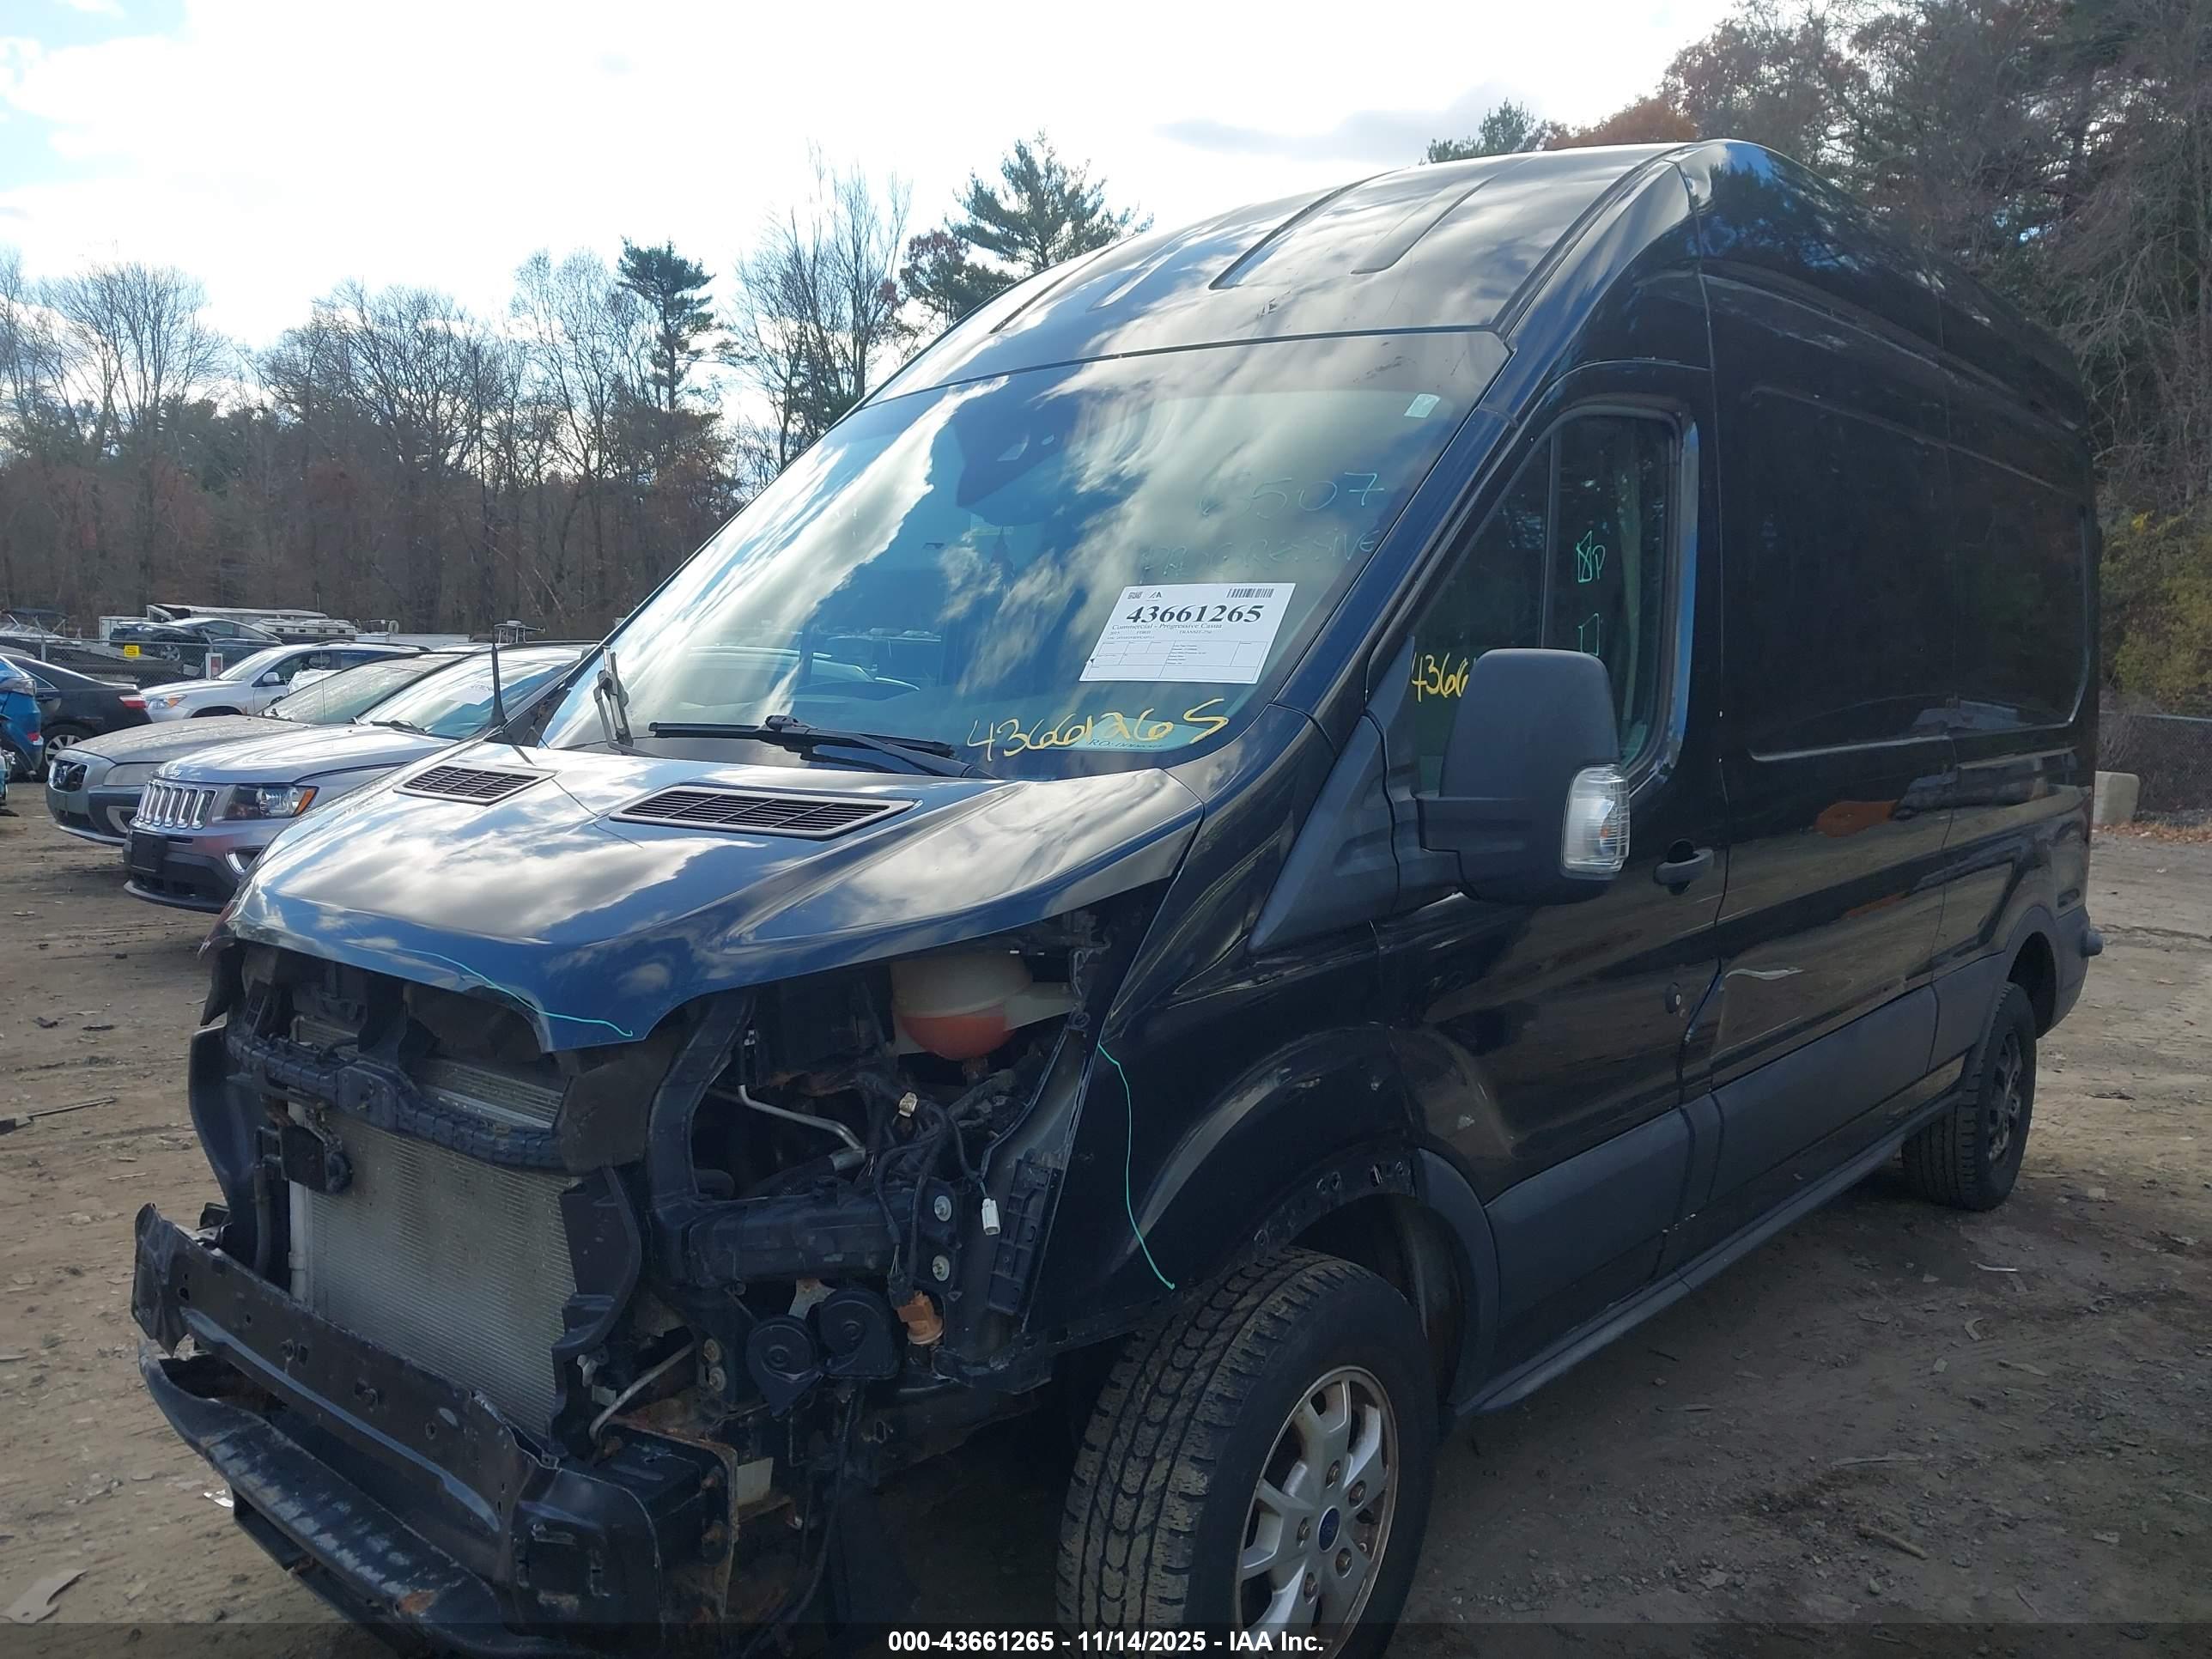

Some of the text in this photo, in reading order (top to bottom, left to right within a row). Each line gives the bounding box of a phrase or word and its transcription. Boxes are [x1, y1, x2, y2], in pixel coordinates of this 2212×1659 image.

[1127, 605, 1264, 623] 43661265
[1411, 652, 1477, 703] 4366
[966, 698, 1230, 763] 43661265
